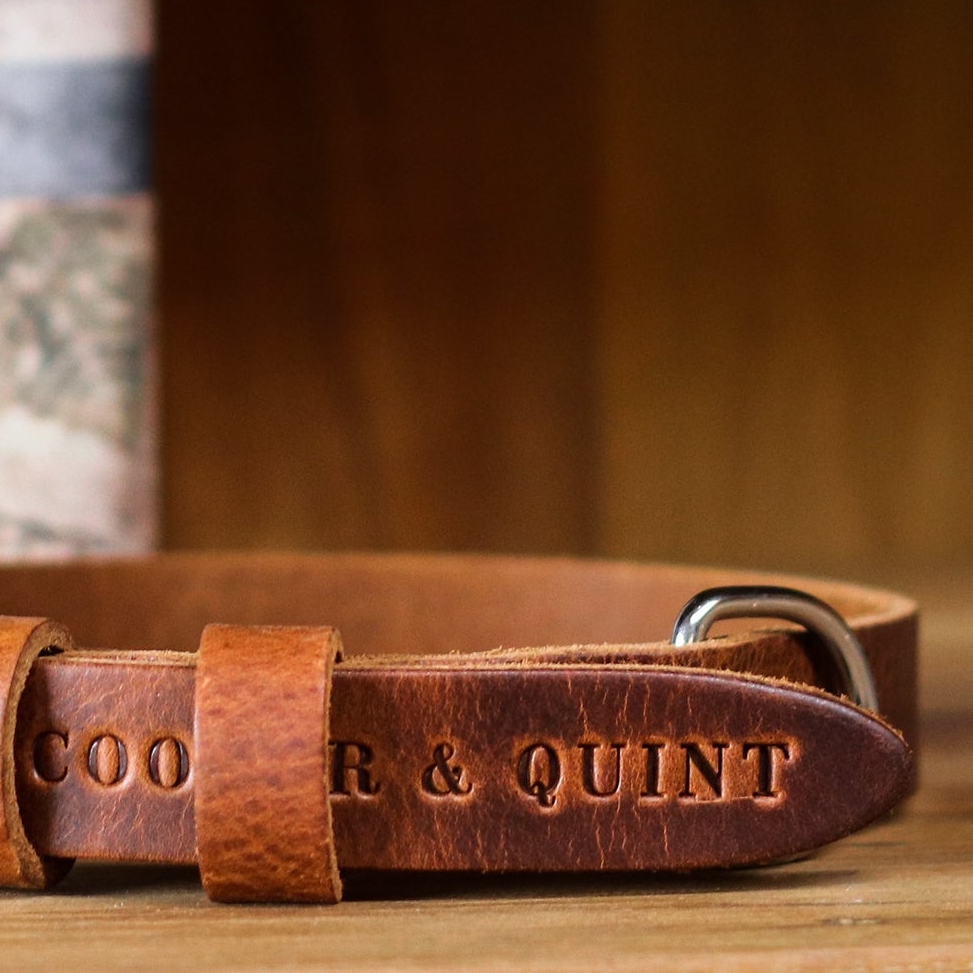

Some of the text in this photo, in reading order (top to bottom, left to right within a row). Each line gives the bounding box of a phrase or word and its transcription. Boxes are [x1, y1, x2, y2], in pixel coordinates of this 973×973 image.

[31, 730, 791, 809] COOR & QUINT
